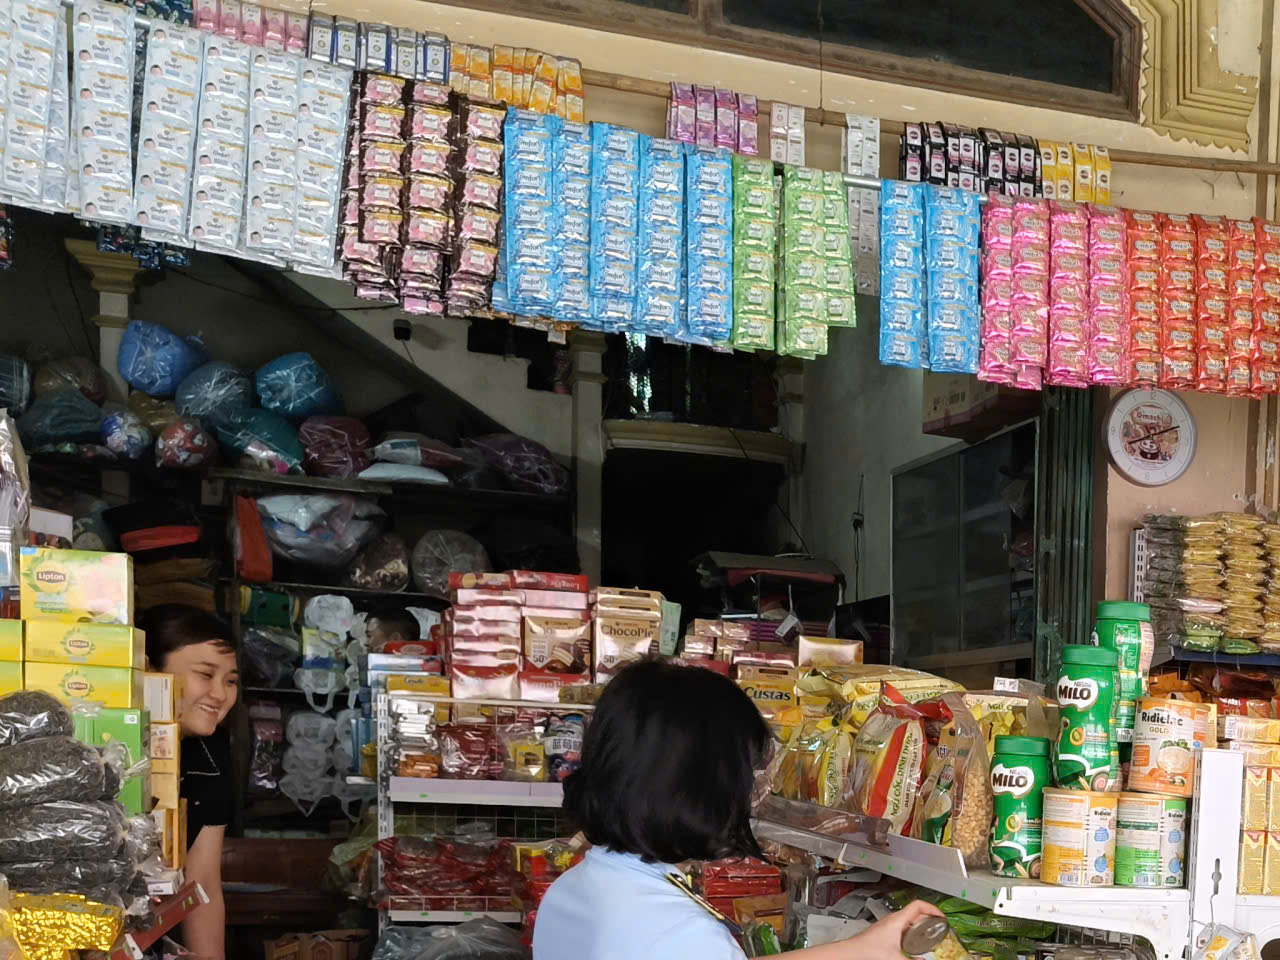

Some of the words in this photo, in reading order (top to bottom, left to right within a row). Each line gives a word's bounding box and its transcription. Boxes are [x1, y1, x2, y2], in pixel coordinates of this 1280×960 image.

[602, 624, 654, 638] ChocoPie
[743, 687, 791, 701] Custas
[1058, 685, 1092, 701] MILO
[992, 773, 1028, 788] MILO
